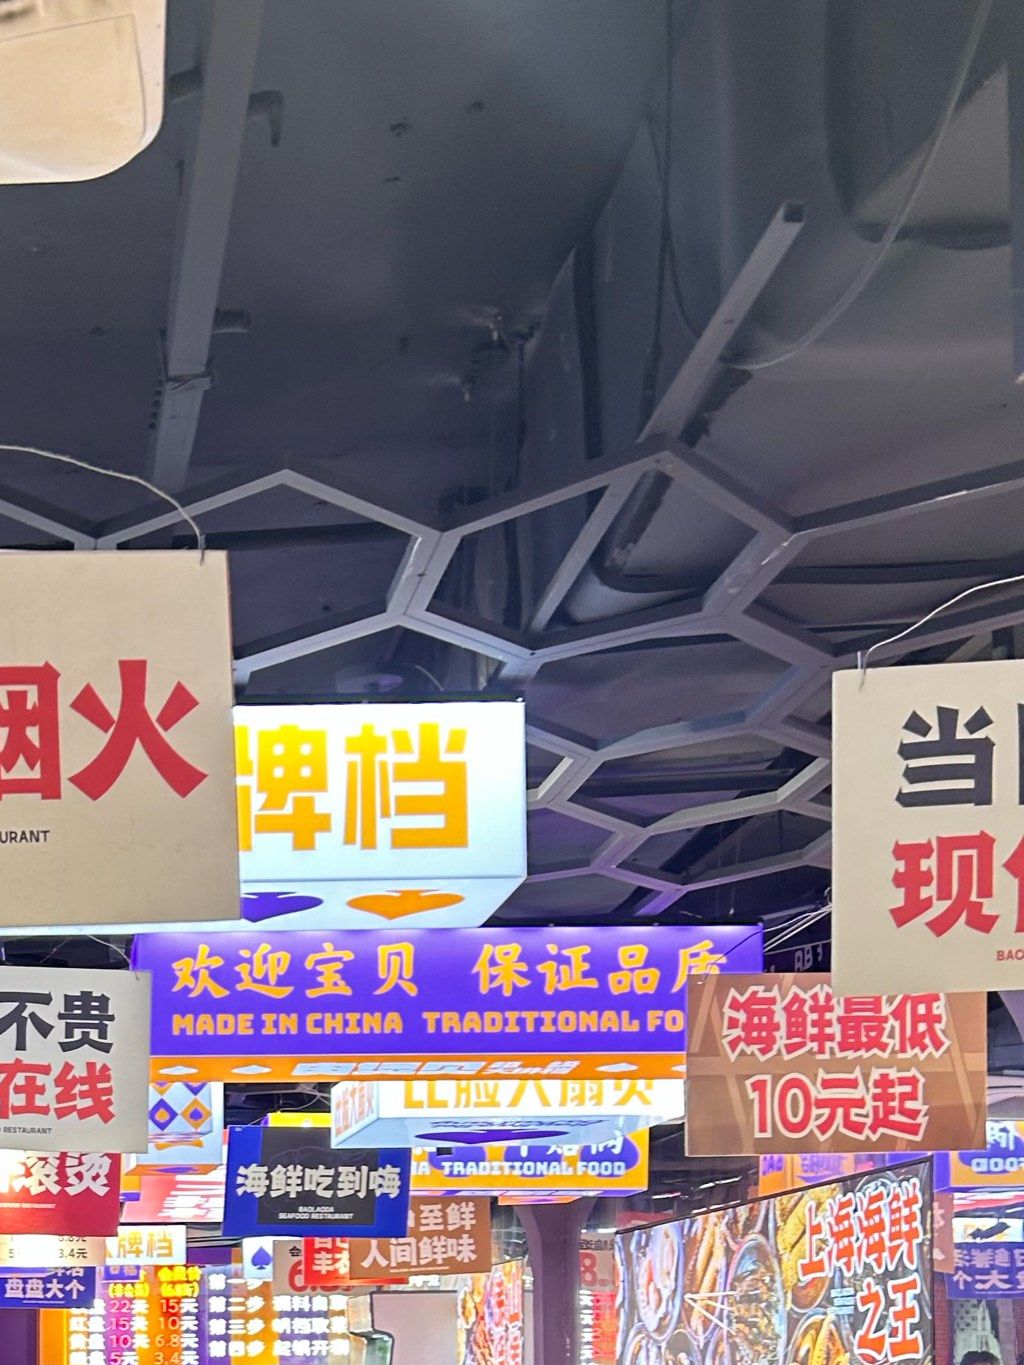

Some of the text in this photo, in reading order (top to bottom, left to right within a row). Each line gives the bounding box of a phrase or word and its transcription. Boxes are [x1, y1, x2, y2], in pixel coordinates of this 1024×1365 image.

[895, 704, 1024, 808] 当
[237, 722, 468, 851] 牌档
[171, 939, 728, 999] 欢迎宝贝 保证品质
[171, 1009, 685, 1036] MADE IN CHINA TRADITIONAL FO
[722, 984, 952, 1062] 海鲜最低
[744, 1065, 930, 1142] 10元起
[3, 1126, 53, 1135] RESTAURANT
[236, 1163, 401, 1199] 海鲜吃到嗨
[442, 1161, 573, 1176] TRADITIONAL
[577, 1160, 626, 1176] FOOD
[408, 1201, 477, 1232] 至鲜
[798, 1178, 923, 1281] 上海海鲜
[58, 1248, 89, 1260] 3.4元
[105, 1229, 175, 1259] 牌档
[360, 1234, 478, 1269] 人间鲜味
[4, 1278, 86, 1300] 盘盘大个
[160, 1298, 199, 1313] 15元
[855, 1272, 924, 1362] 之王
[159, 1316, 199, 1331] 10元
[155, 1333, 199, 1348] 6.8元
[110, 1351, 139, 1365] 5元
[155, 1350, 199, 1365] 3.4元
